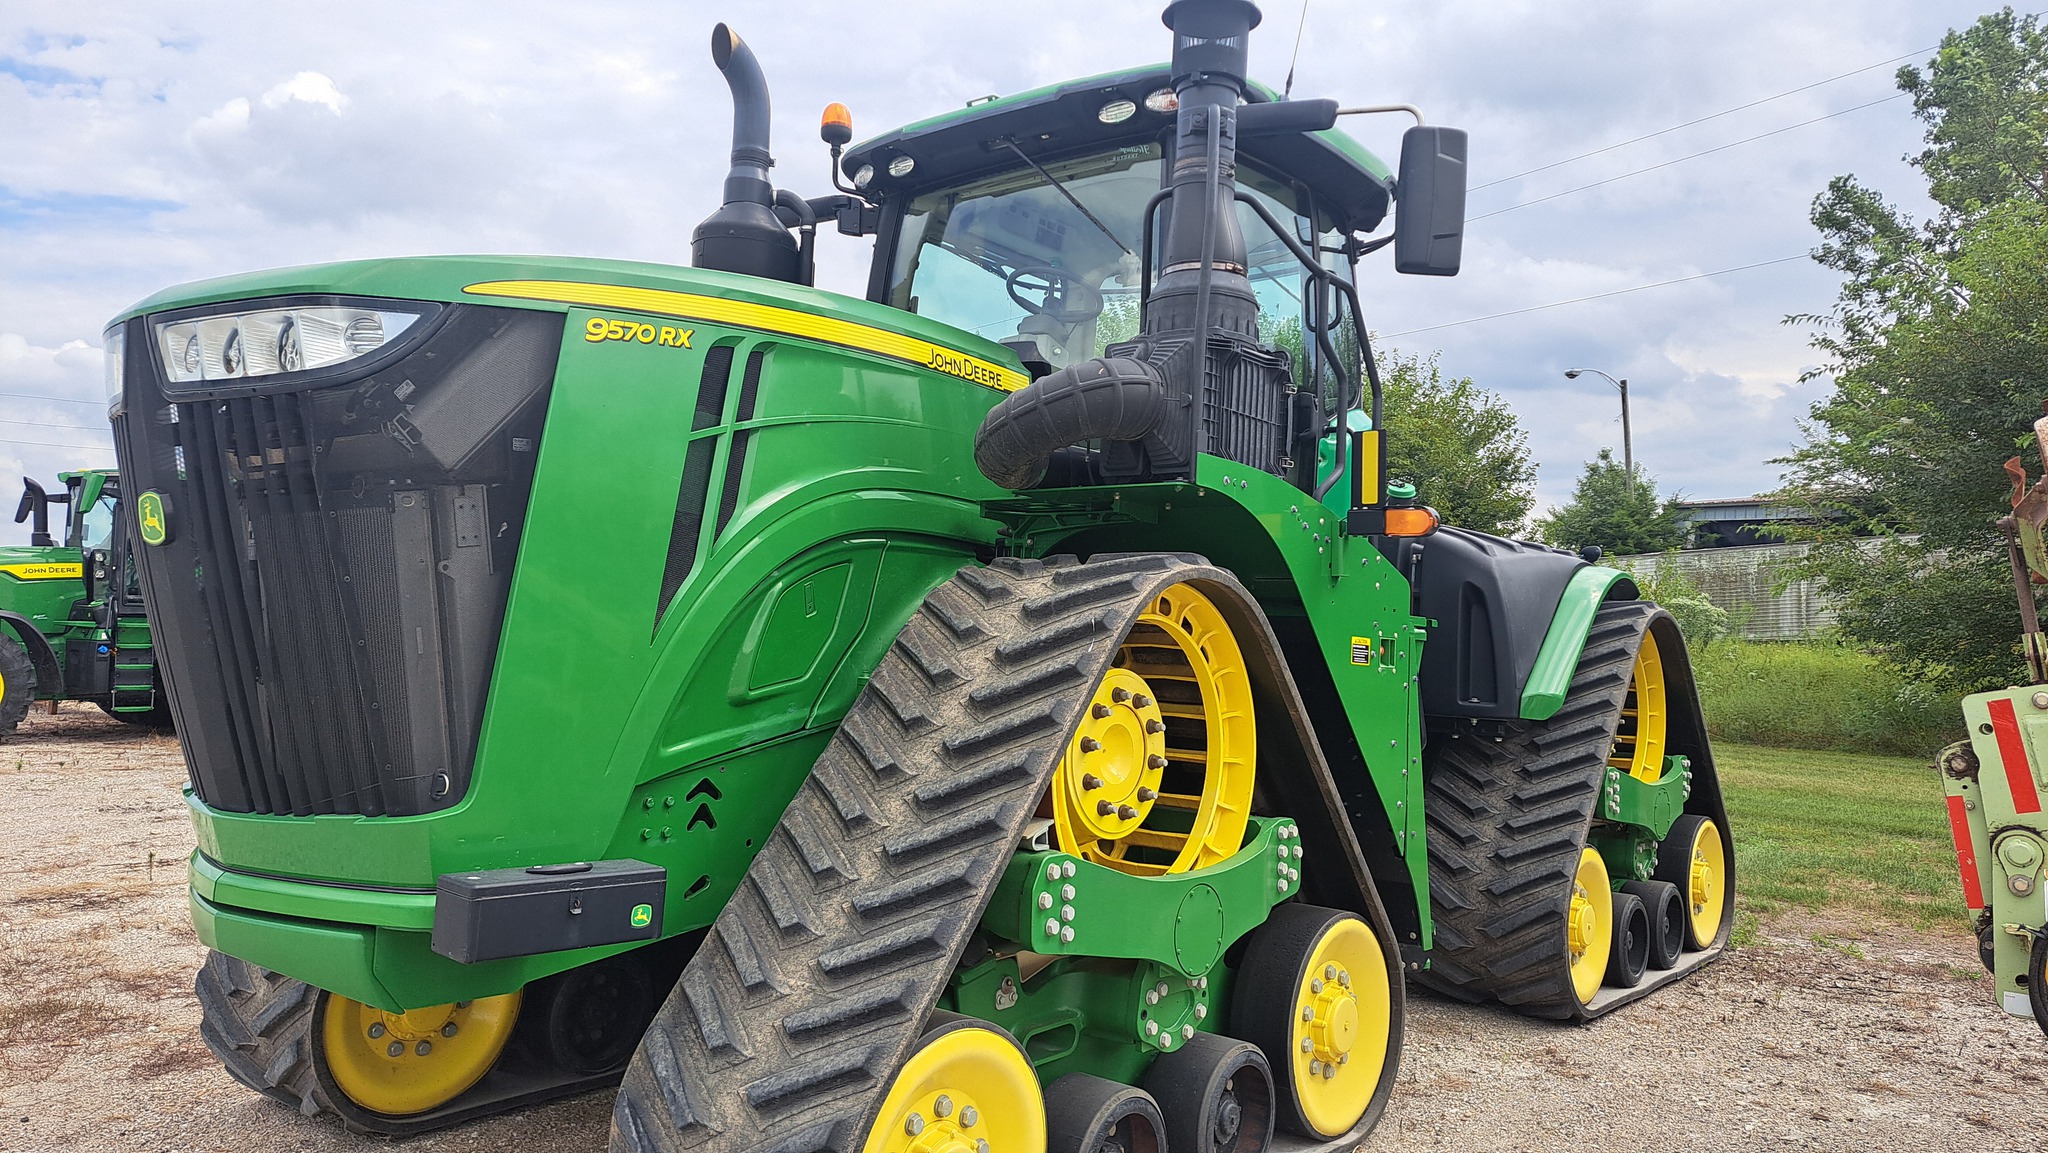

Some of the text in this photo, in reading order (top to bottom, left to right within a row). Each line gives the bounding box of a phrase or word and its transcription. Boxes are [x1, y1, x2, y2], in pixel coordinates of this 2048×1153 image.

[585, 317, 695, 350] 9570 RX
[927, 348, 1003, 387] JOHN DEERE
[22, 566, 78, 575] JOHN DEERE
